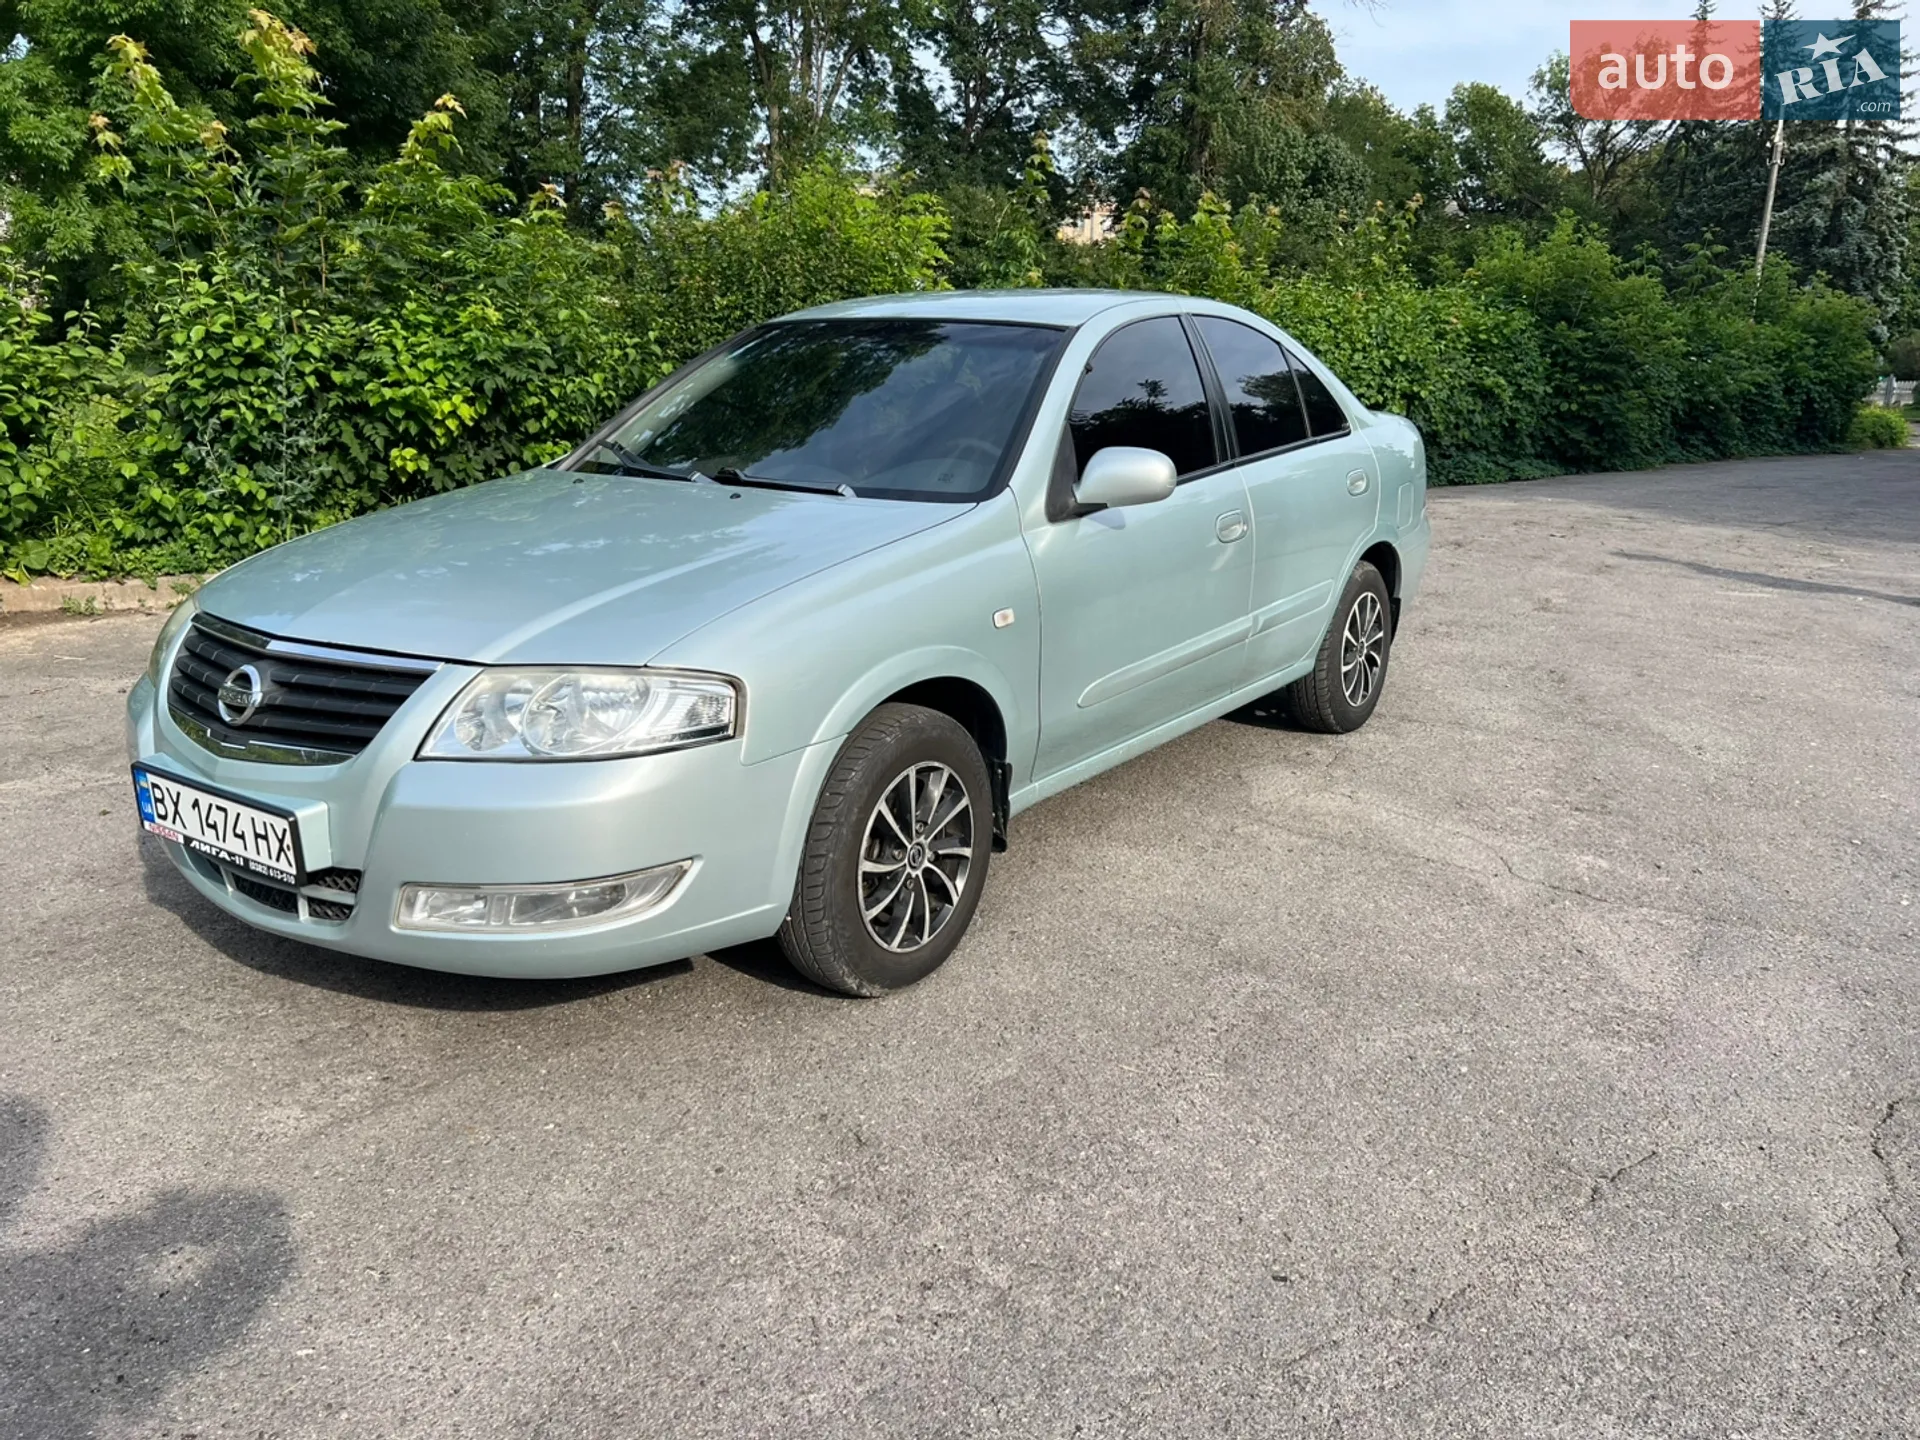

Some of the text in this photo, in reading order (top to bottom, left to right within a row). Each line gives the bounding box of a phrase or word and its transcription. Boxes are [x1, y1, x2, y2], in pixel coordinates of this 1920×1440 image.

[142, 801, 153, 814] UA
[150, 781, 294, 868] BX 1474 HX
